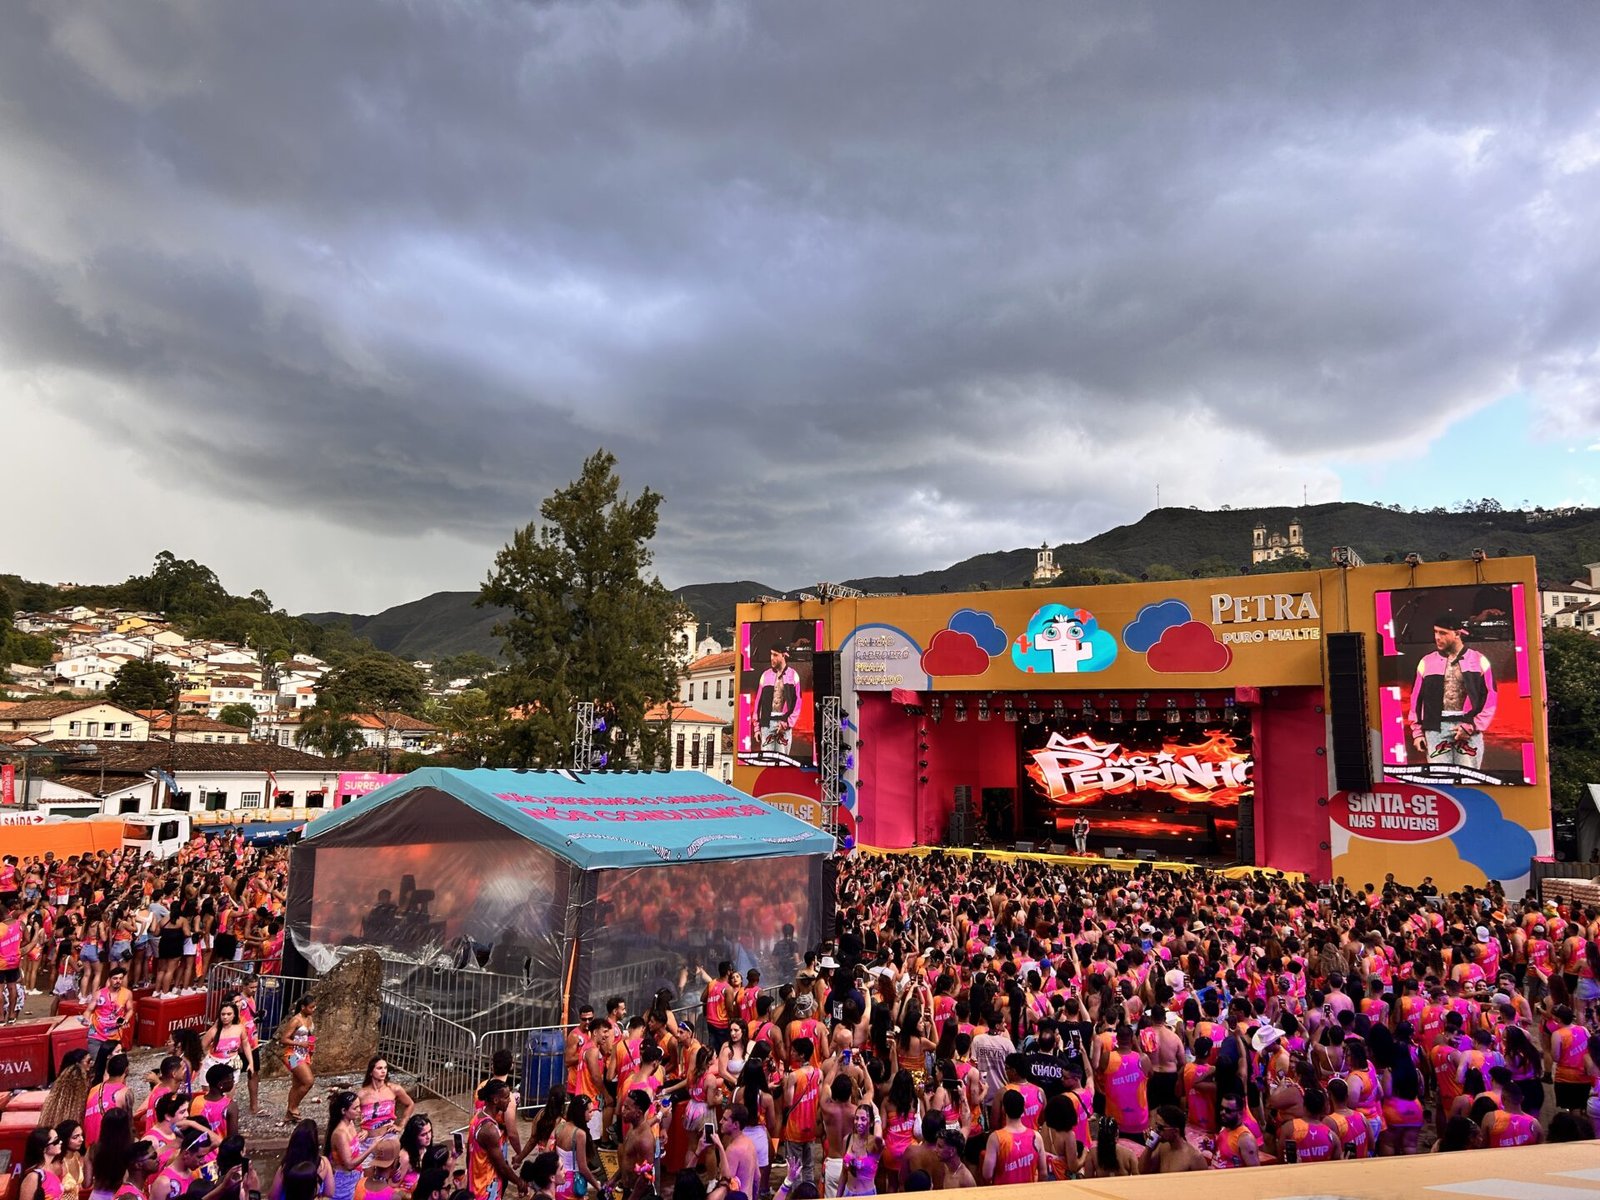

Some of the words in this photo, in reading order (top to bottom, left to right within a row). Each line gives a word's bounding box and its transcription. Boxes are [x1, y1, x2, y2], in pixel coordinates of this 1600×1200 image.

[1210, 592, 1319, 625] PETRA
[1222, 630, 1264, 644] PURO
[1268, 627, 1320, 641] MALTE
[1105, 756, 1151, 767] MC
[493, 792, 546, 803] NÃO
[1348, 793, 1438, 815] SINTA-SE
[518, 806, 599, 821] NÓS
[770, 801, 814, 819] TA-SE
[4, 813, 33, 825] SAÍDA
[1349, 815, 1375, 828] NAS
[1381, 815, 1439, 831] NUVENS!
[1031, 1064, 1062, 1078] CHAOS
[1125, 1072, 1139, 1083] VIP
[1025, 1104, 1039, 1115] VIP
[1312, 1145, 1329, 1156] VIP
[1018, 1153, 1034, 1168] VIP
